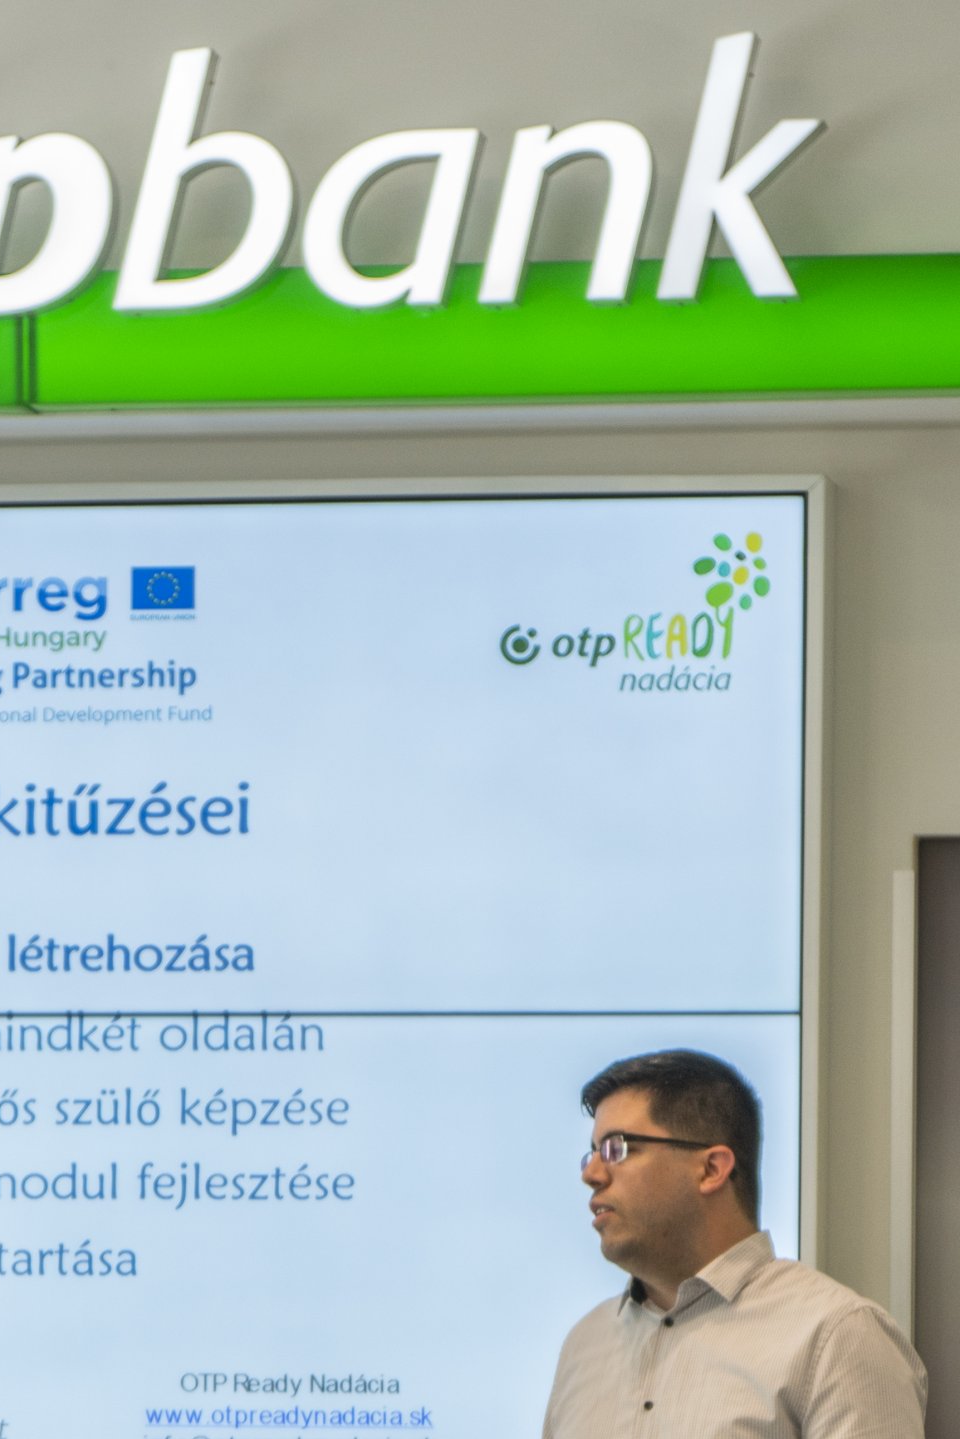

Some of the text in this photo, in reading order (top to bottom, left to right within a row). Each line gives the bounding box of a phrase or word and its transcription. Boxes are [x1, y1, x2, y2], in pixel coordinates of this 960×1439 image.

[552, 628, 617, 667] otp
[12, 659, 197, 695] Partnership
[618, 664, 732, 692] nadácia
[42, 704, 161, 725] Development
[167, 704, 213, 722] Fund
[7, 934, 256, 973] létrehozása
[159, 1011, 326, 1053] oldalán
[54, 1087, 162, 1127] szülő
[178, 1088, 351, 1136] képzése
[138, 1162, 356, 1210] fejlesztése
[180, 1373, 401, 1398] OTP Ready Nadácia
[145, 1407, 434, 1430] www.otpreadynadacia.sk
